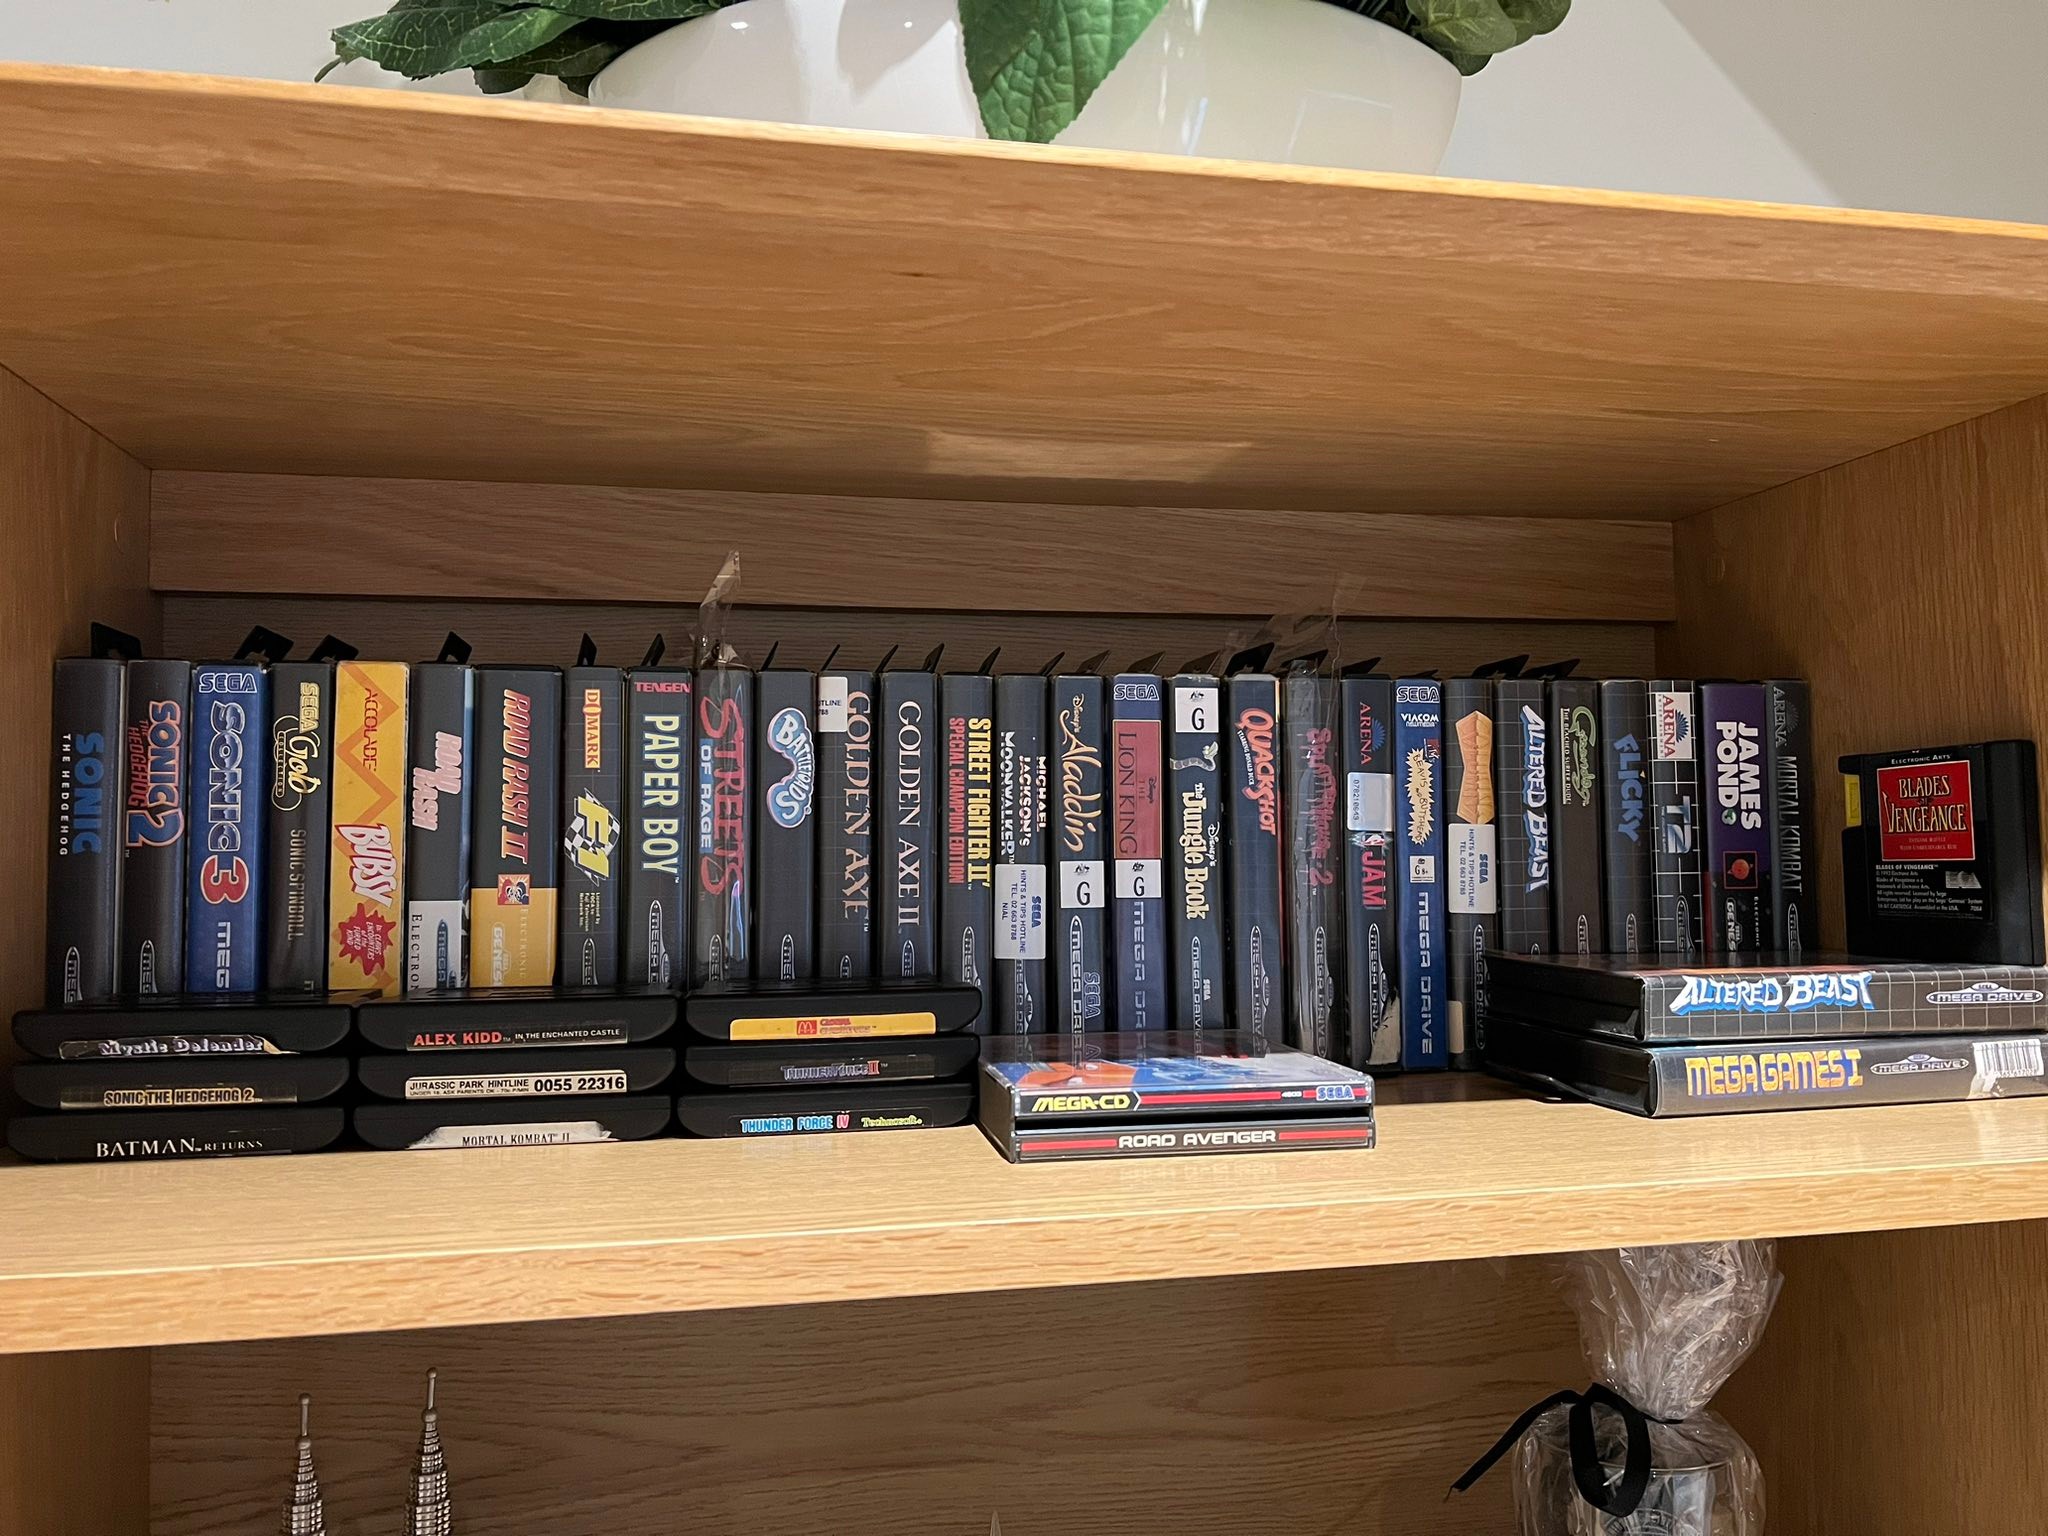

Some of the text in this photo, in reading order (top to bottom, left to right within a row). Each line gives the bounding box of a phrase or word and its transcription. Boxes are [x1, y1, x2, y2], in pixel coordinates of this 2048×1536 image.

[200, 672, 257, 694] SEGA
[300, 682, 320, 734] SEGA
[634, 682, 690, 694] TENGEN
[1114, 684, 1160, 700] SEGA
[1396, 686, 1440, 703] SEGA
[362, 687, 380, 773] ACCOLADE
[583, 689, 601, 769] DOMARK
[1190, 708, 1206, 731] G
[1360, 701, 1372, 765] ARENA
[1400, 713, 1439, 722] VIACOM
[1662, 695, 1676, 758] ARENA
[1773, 686, 1787, 747] ARENA
[126, 701, 184, 846] SONIC 2
[502, 689, 531, 864] ROAD RASH II
[776, 714, 812, 820] BATTLETOADS
[968, 718, 992, 784] STREET
[1060, 710, 1102, 852] Aladdin
[1716, 722, 1739, 808] POND
[1738, 722, 1762, 830] JAMES
[59, 734, 71, 855] THE HEDGEHOG
[73, 731, 104, 855] SONIC
[200, 701, 250, 905] SONIC 3
[642, 715, 680, 875] PAPER BOY
[700, 696, 744, 894] STREETS
[700, 744, 712, 848] OF RAGE
[842, 692, 870, 919] GOLDEN AXE
[898, 700, 922, 926] GOLDEN AXE II
[949, 716, 966, 884] SPECIAL CHAMPION EDITION
[1000, 731, 1016, 856] MOONWALKER
[1018, 756, 1032, 846] JACKSON'S
[1036, 756, 1046, 832] MICHAEL
[1118, 733, 1137, 854] LION KING
[1413, 754, 1428, 841] BEAVIS BUTT-HEAD
[1520, 705, 1549, 893] ALTERED BEAST
[1613, 733, 1644, 843] FLICKY
[1882, 792, 1967, 832] VENGEANCE
[1899, 775, 1950, 798] BLADES
[574, 796, 610, 880] F1
[968, 788, 992, 859] FIGHTER
[1666, 796, 1692, 854] T2
[1777, 756, 1802, 890] MORTAL KOMBAT
[287, 829, 306, 942] SONIC SPINBALL
[335, 823, 398, 908] BUBSY
[1133, 876, 1146, 898] G
[1180, 792, 1209, 920] Jungle Book
[1361, 851, 1386, 910] JAM
[1415, 865, 1420, 875] G
[1479, 854, 1488, 884] SEGA
[1032, 896, 1042, 928] SEGA
[1076, 882, 1091, 906] G
[1418, 892, 1430, 968] MEGA
[1072, 931, 1081, 993] MEGA
[1084, 972, 1100, 1019] SEGA
[1421, 976, 1432, 1054] DRIVE
[1669, 972, 1876, 1016] ALTERED BEAST
[1936, 993, 2033, 1002] MEGA DRIVE
[98, 1037, 264, 1056] Mystic Defender
[414, 1033, 456, 1046] ALEX
[463, 1032, 502, 1044] KIDD
[542, 1030, 589, 1038] ENCHANTED
[1879, 1060, 1961, 1073] MEGA DRIVE
[104, 1087, 254, 1106] SONIC THE HEDGEHOG 2
[410, 1079, 529, 1090] JURASSIC PARK HINTLINE
[534, 1077, 625, 1092] 0055 22316
[1032, 1095, 1131, 1112] MEGA-CD
[1316, 1085, 1355, 1101] SEGA
[96, 1138, 263, 1158] BATMAN RETURNS
[462, 1133, 570, 1147] MORTAL KOMBAT II
[741, 1114, 849, 1133] THUNDER FORCE IV
[1118, 1130, 1276, 1149] ROAD AVENGER
